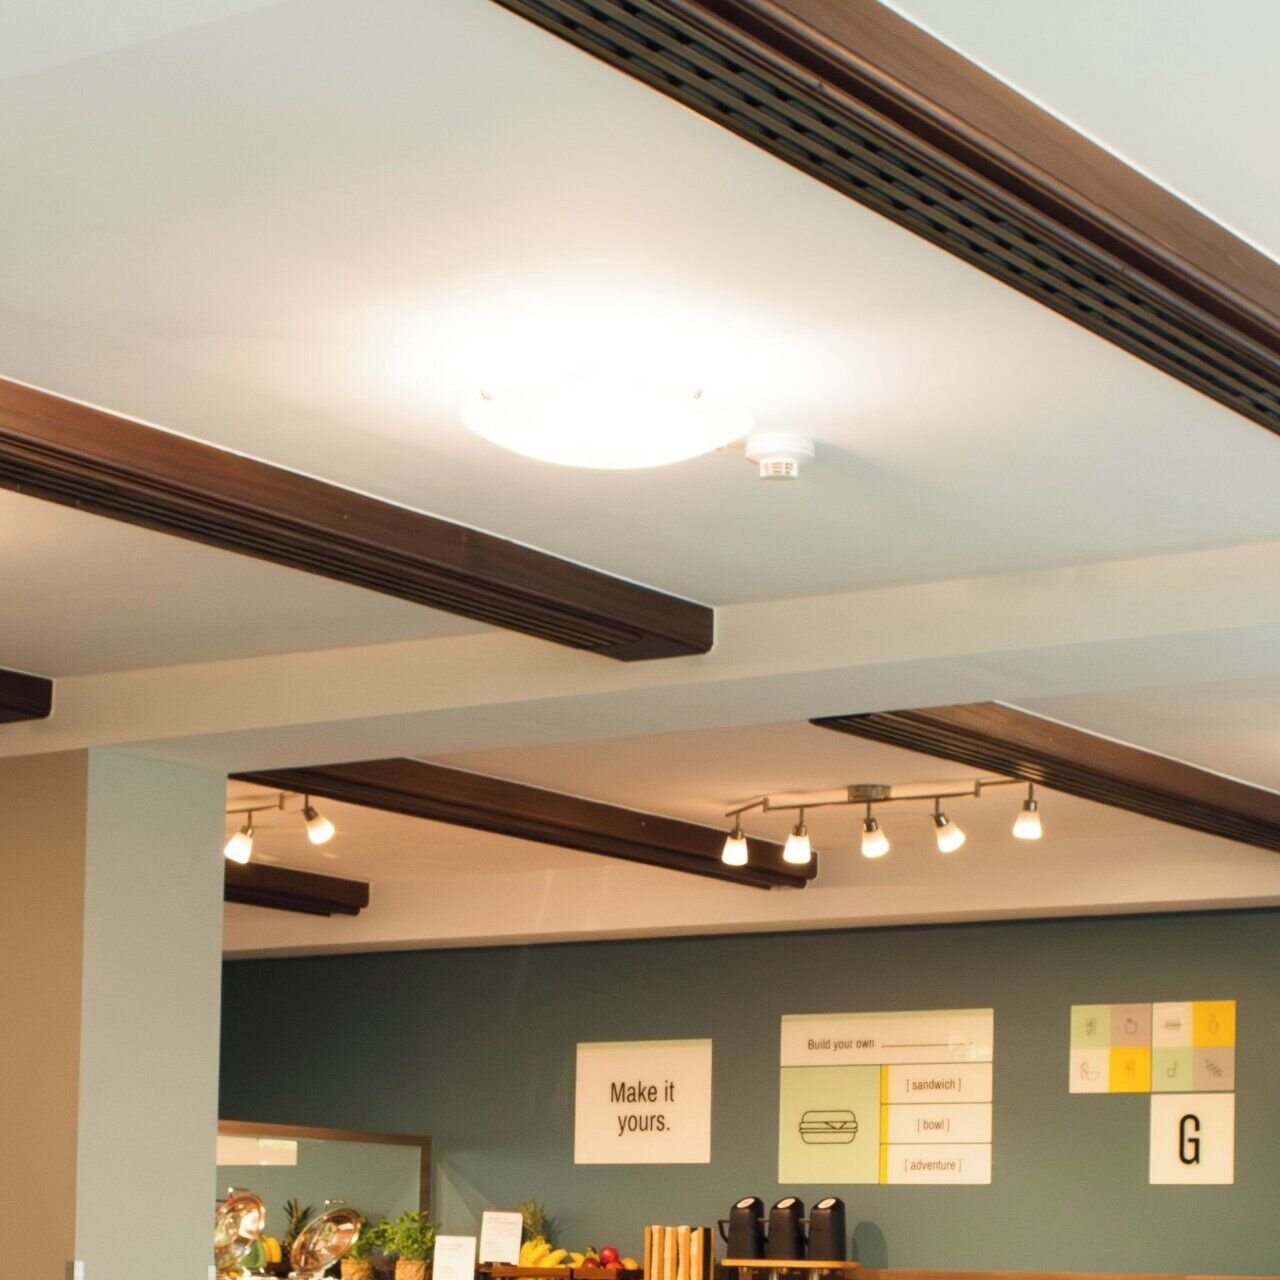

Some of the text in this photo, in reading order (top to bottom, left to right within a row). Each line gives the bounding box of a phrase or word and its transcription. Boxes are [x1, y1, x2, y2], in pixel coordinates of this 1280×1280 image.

[807, 1038, 875, 1052] Build your own
[610, 1079, 675, 1103] Make it
[911, 1078, 956, 1091] sandwich
[617, 1113, 671, 1137] yours.
[923, 1119, 945, 1131] bowl
[1179, 1114, 1201, 1165] G
[910, 1160, 957, 1171] adventure
